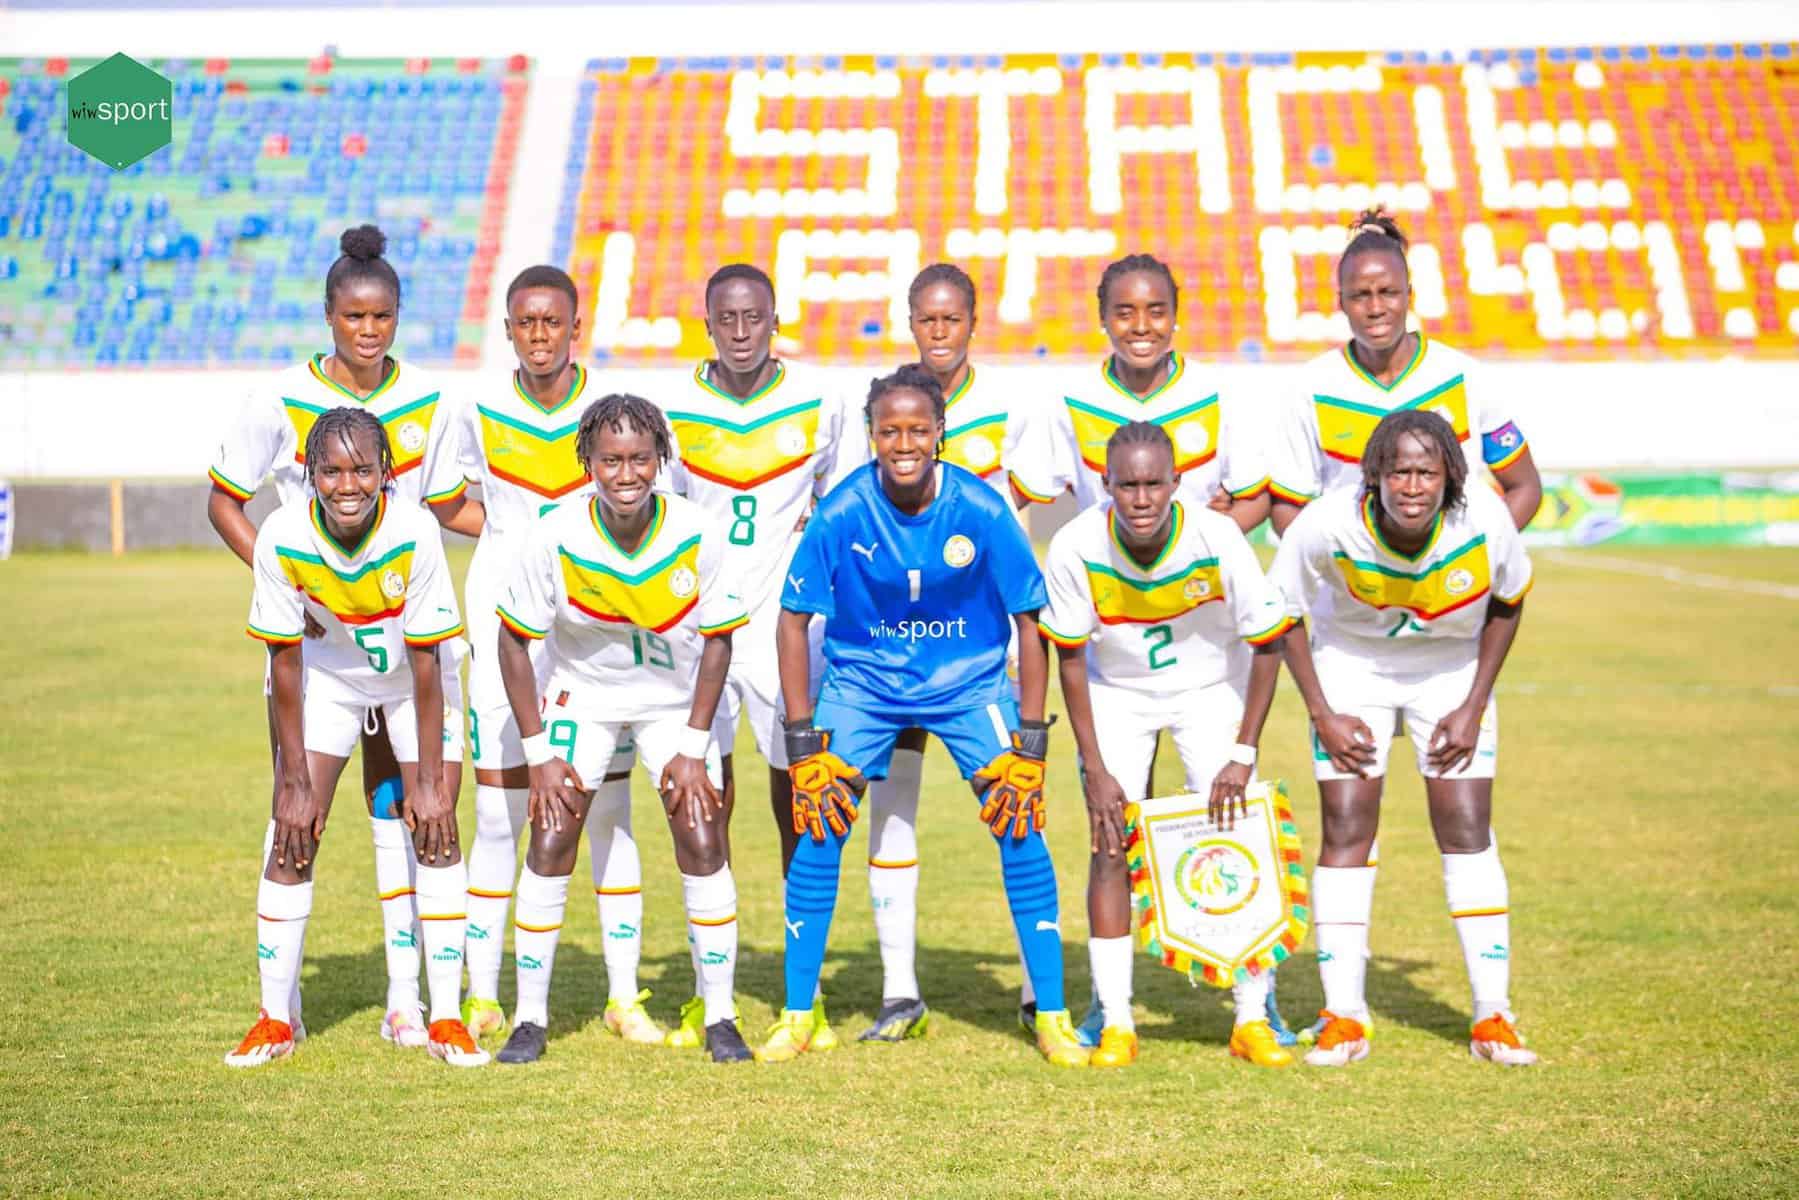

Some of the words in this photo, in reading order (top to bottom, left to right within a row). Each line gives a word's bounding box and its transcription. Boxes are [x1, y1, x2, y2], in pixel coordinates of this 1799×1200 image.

[728, 494, 757, 546] 8
[907, 569, 921, 602] 1
[354, 626, 389, 674] 5
[631, 628, 675, 671] 19
[1143, 624, 1177, 671] 2
[541, 718, 578, 764] 9
[986, 703, 1013, 749] 1
